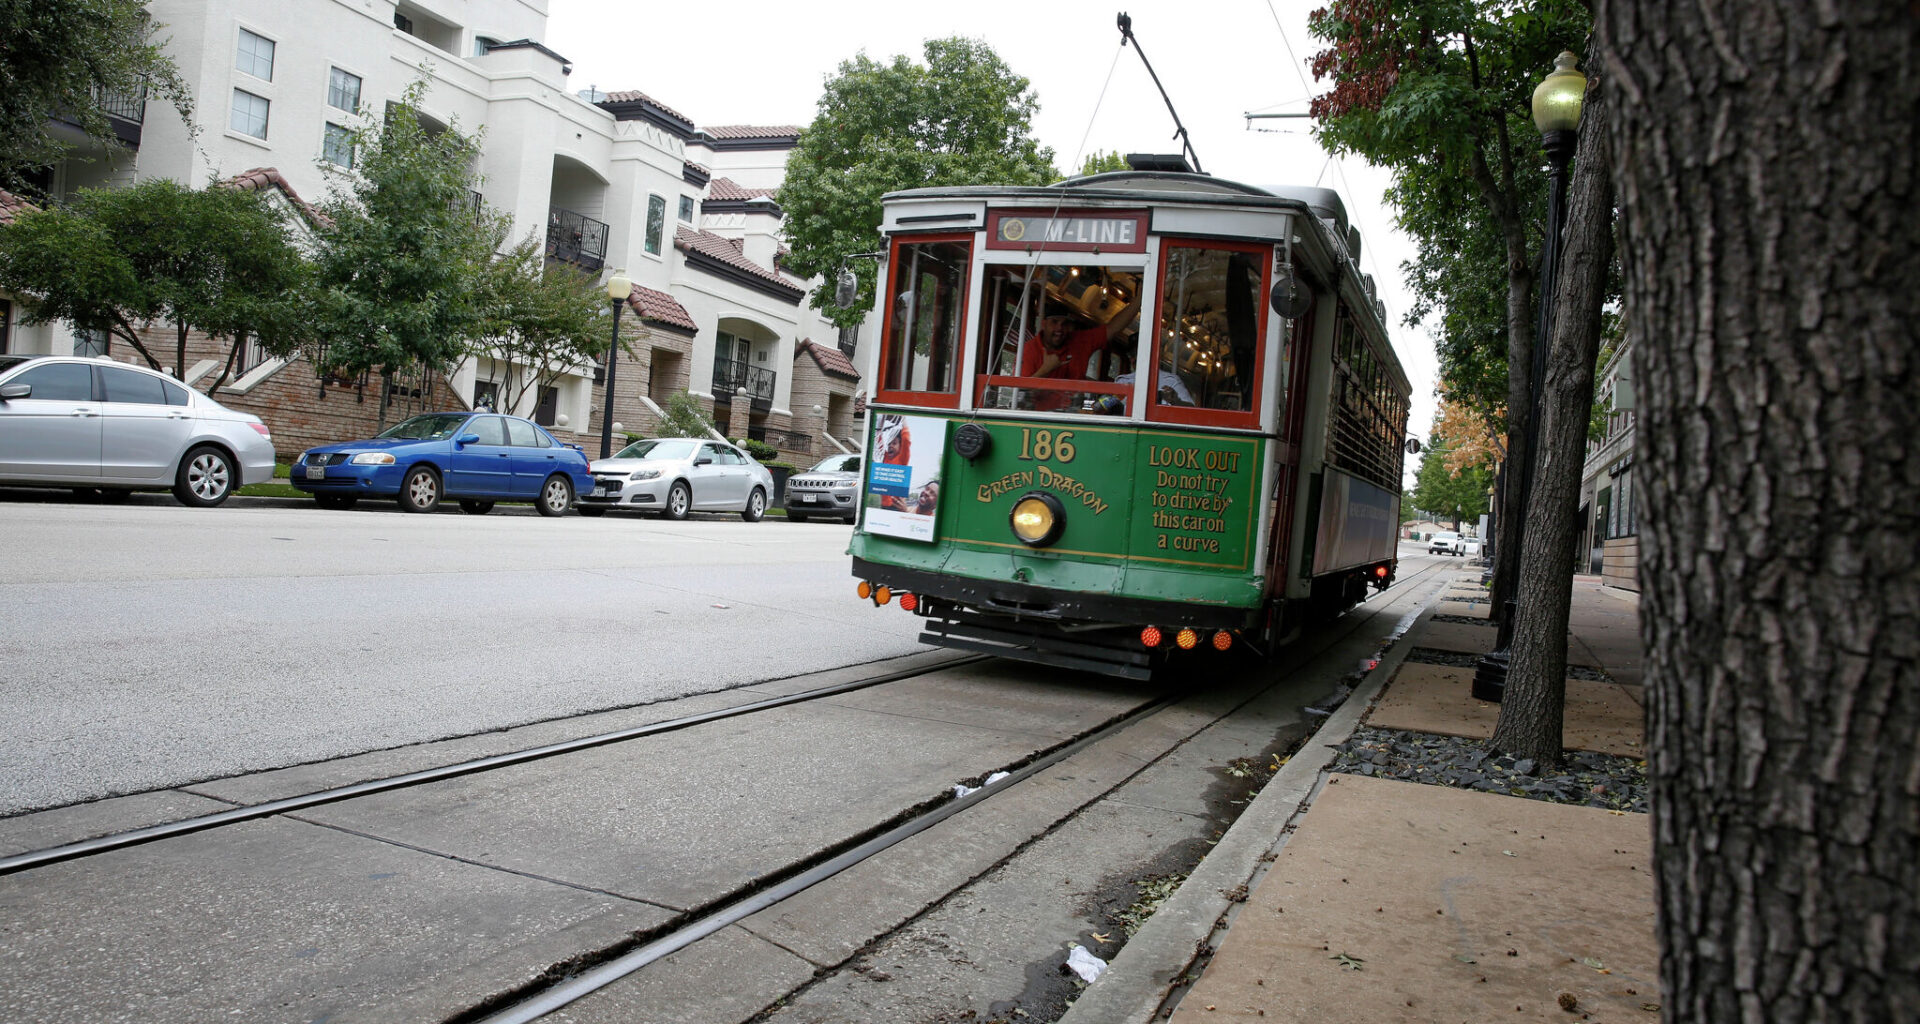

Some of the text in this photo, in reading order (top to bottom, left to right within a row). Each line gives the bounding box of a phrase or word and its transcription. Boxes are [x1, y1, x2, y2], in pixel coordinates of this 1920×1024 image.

[1045, 219, 1132, 244] M-LINE
[1018, 428, 1076, 464] 186
[1149, 445, 1241, 474] LOOK OUT
[976, 465, 1109, 515] GREEN DRAGON
[1157, 470, 1230, 496] Do not try
[1152, 490, 1231, 517] to drive by
[1152, 510, 1225, 533] this car on
[1158, 534, 1220, 554] a curve
